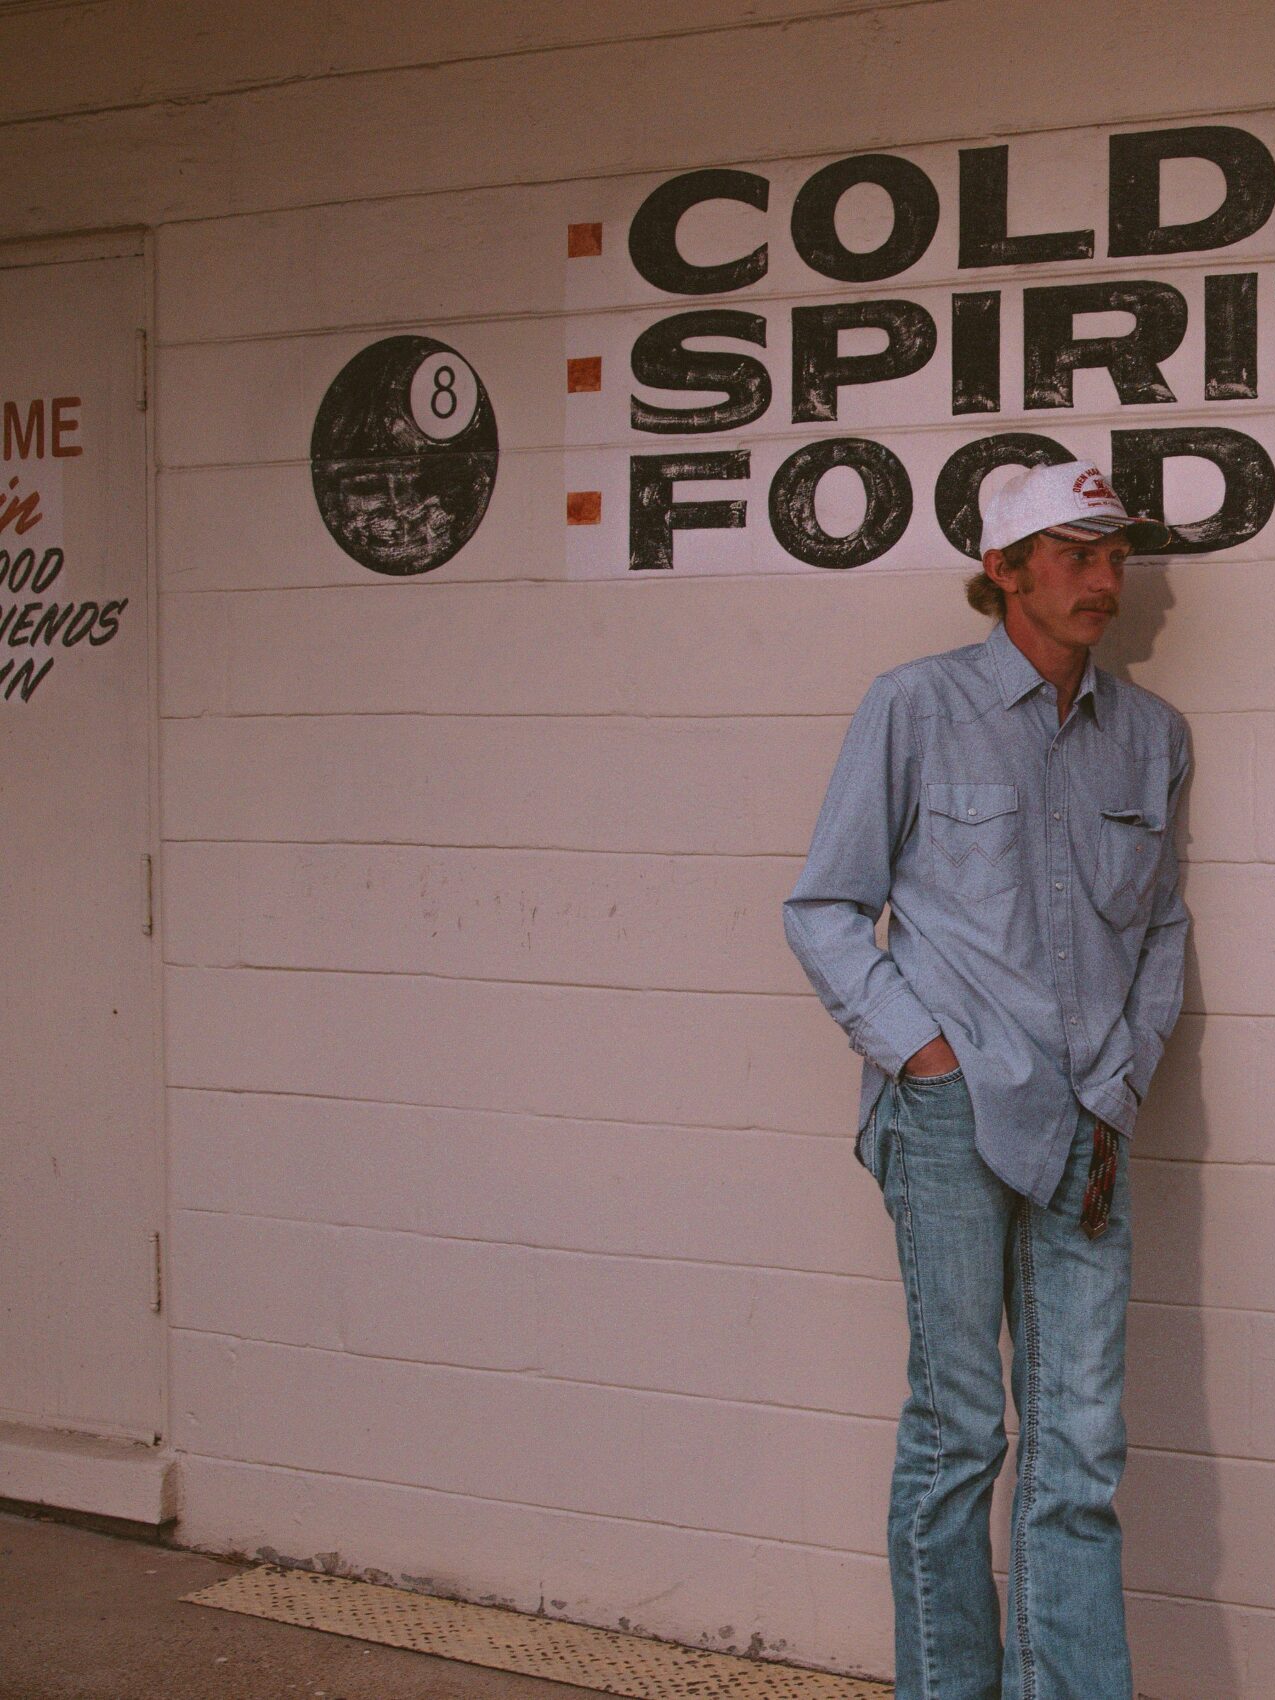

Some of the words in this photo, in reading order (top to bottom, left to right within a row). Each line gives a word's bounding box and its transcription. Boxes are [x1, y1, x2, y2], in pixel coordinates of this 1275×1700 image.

[430, 365, 457, 419] 8
[1072, 473, 1088, 493] OWEN
[0, 597, 128, 647] IENDS
